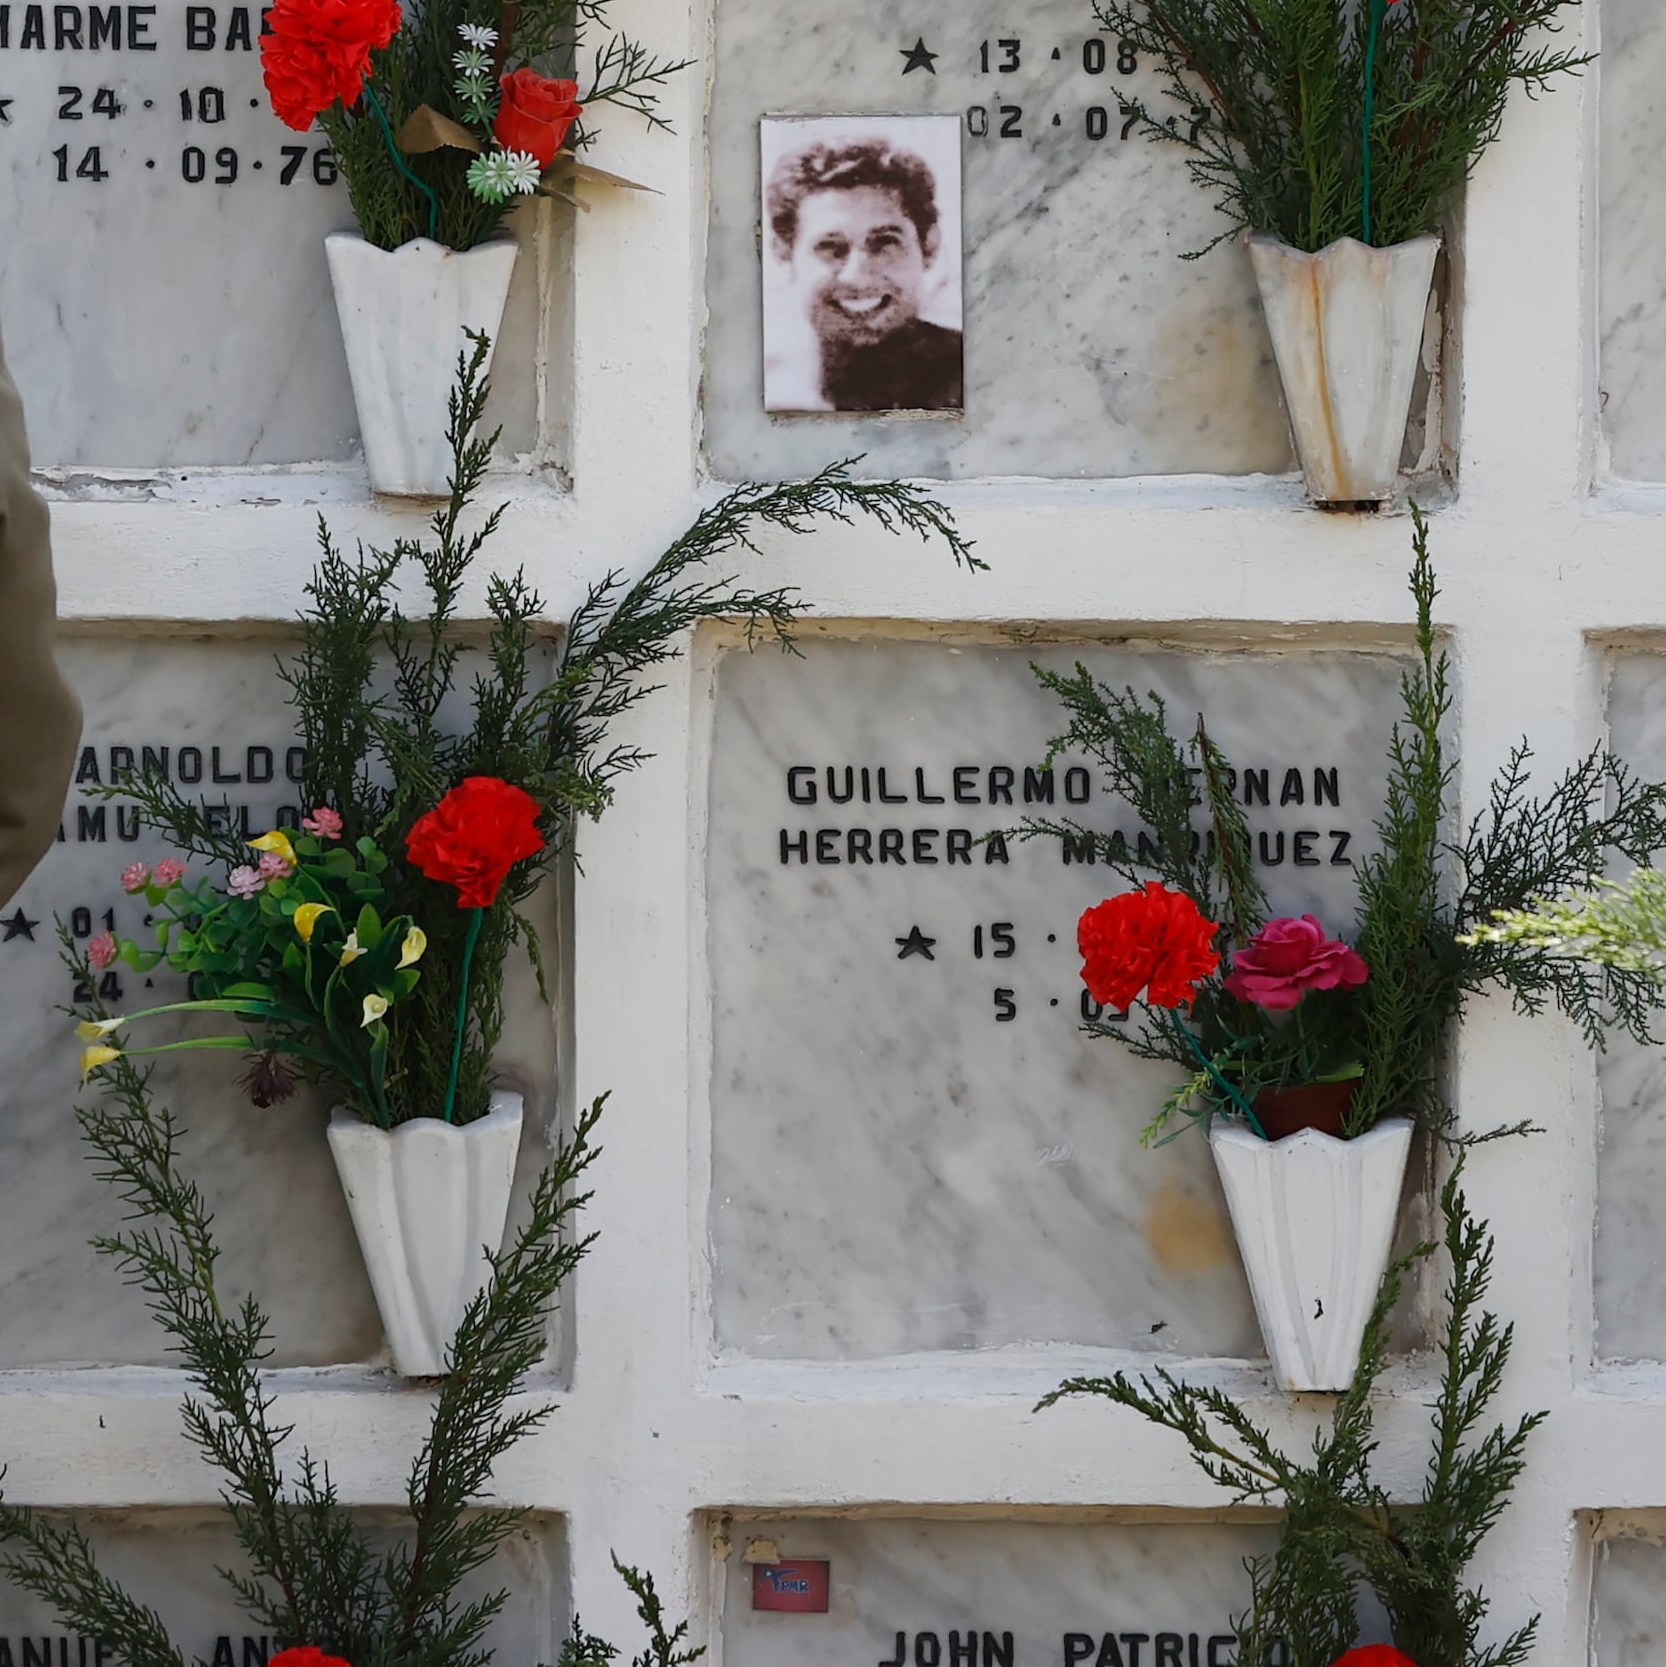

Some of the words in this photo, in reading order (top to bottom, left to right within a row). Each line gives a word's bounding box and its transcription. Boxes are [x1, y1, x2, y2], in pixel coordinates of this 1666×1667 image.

[979, 38, 1022, 75] 13
[1082, 38, 1138, 75] 08
[57, 85, 122, 120] 24
[180, 85, 226, 123] 10
[966, 105, 1023, 138] 02
[1085, 106, 1141, 141] 07
[53, 144, 109, 183] 14
[182, 146, 238, 184] 09
[280, 145, 338, 186] 76
[787, 765, 1091, 805] GUILLERMO
[1144, 767, 1341, 807] ENAN
[779, 828, 1010, 865] HERRERA
[1062, 829, 1353, 866] MANIUEZ
[71, 906, 116, 940] 01
[973, 922, 1016, 959] 15
[993, 987, 1017, 1022] 5
[878, 1630, 1015, 1667] JOHN
[1063, 1632, 1293, 1667] PATRICO
